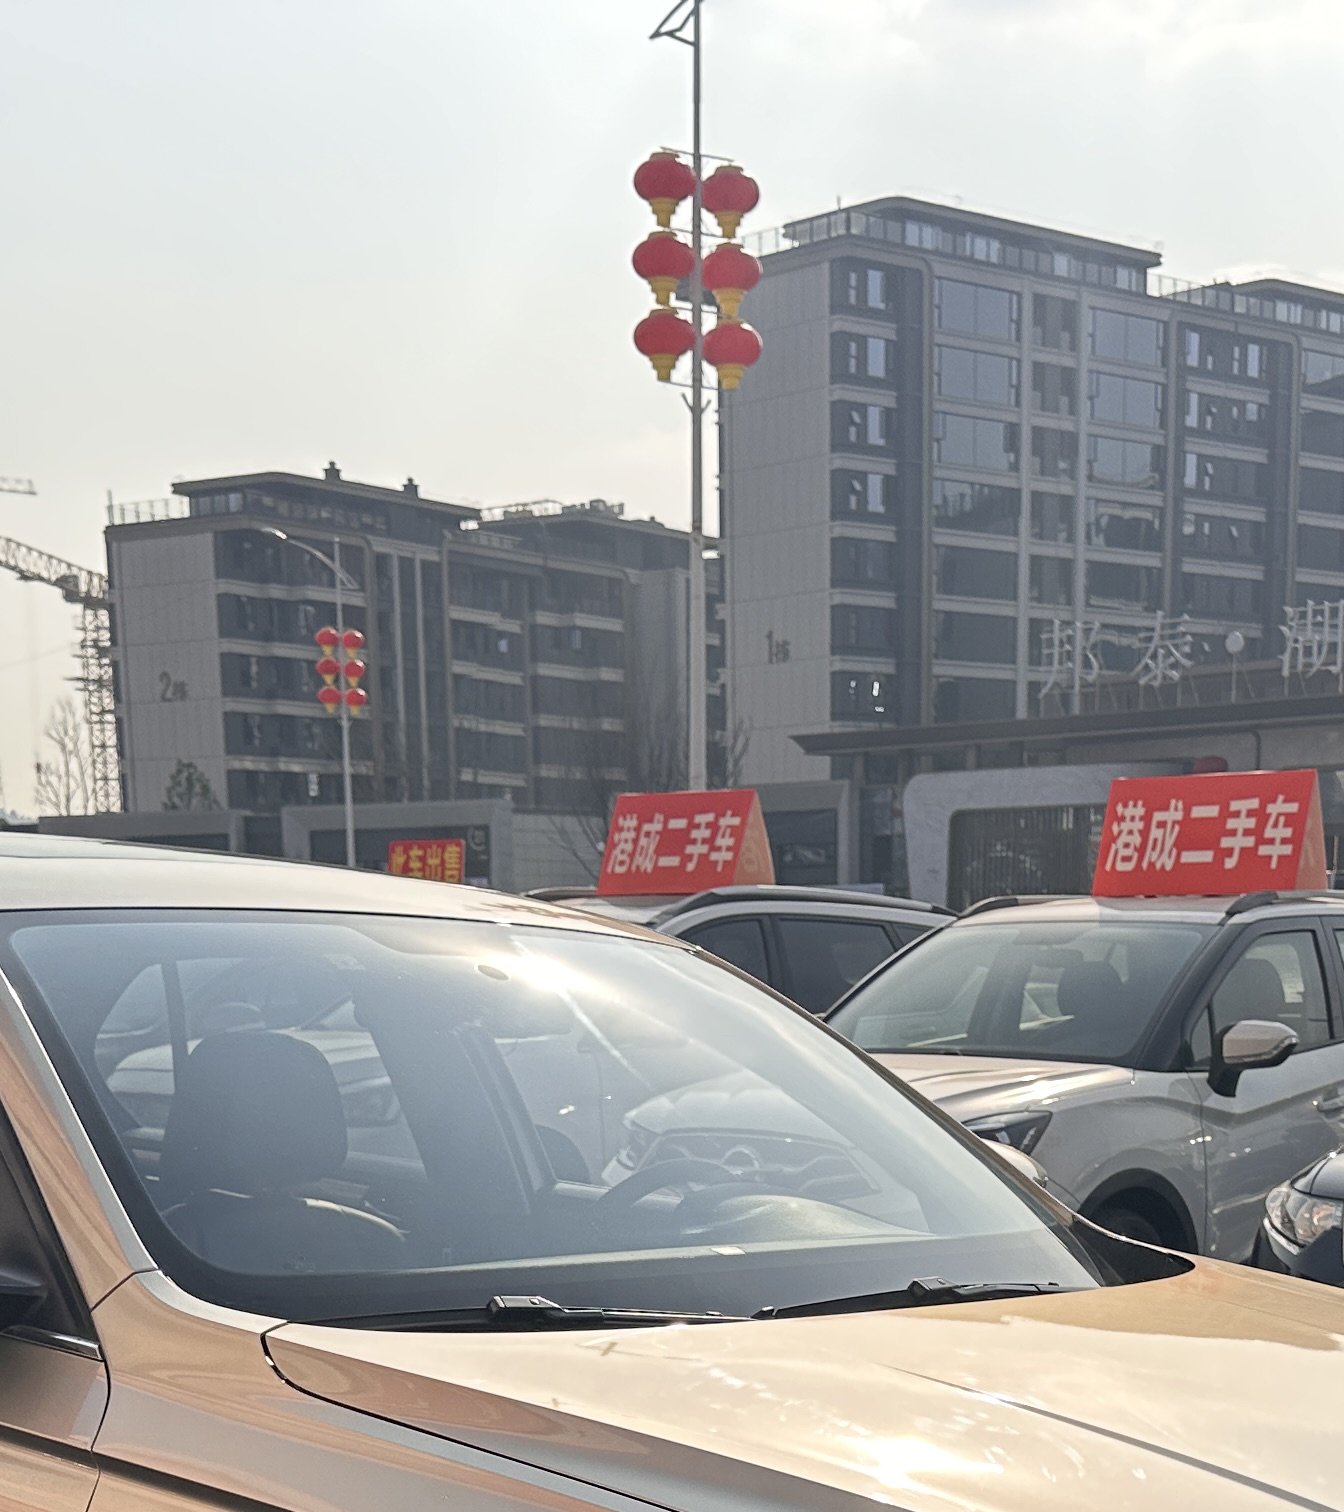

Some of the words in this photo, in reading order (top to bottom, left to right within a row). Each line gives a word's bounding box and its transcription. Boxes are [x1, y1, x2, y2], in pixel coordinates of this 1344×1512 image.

[390, 844, 462, 881] 此车出售
[607, 809, 742, 874] 港成二手车
[1104, 794, 1300, 873] 港成二手车
